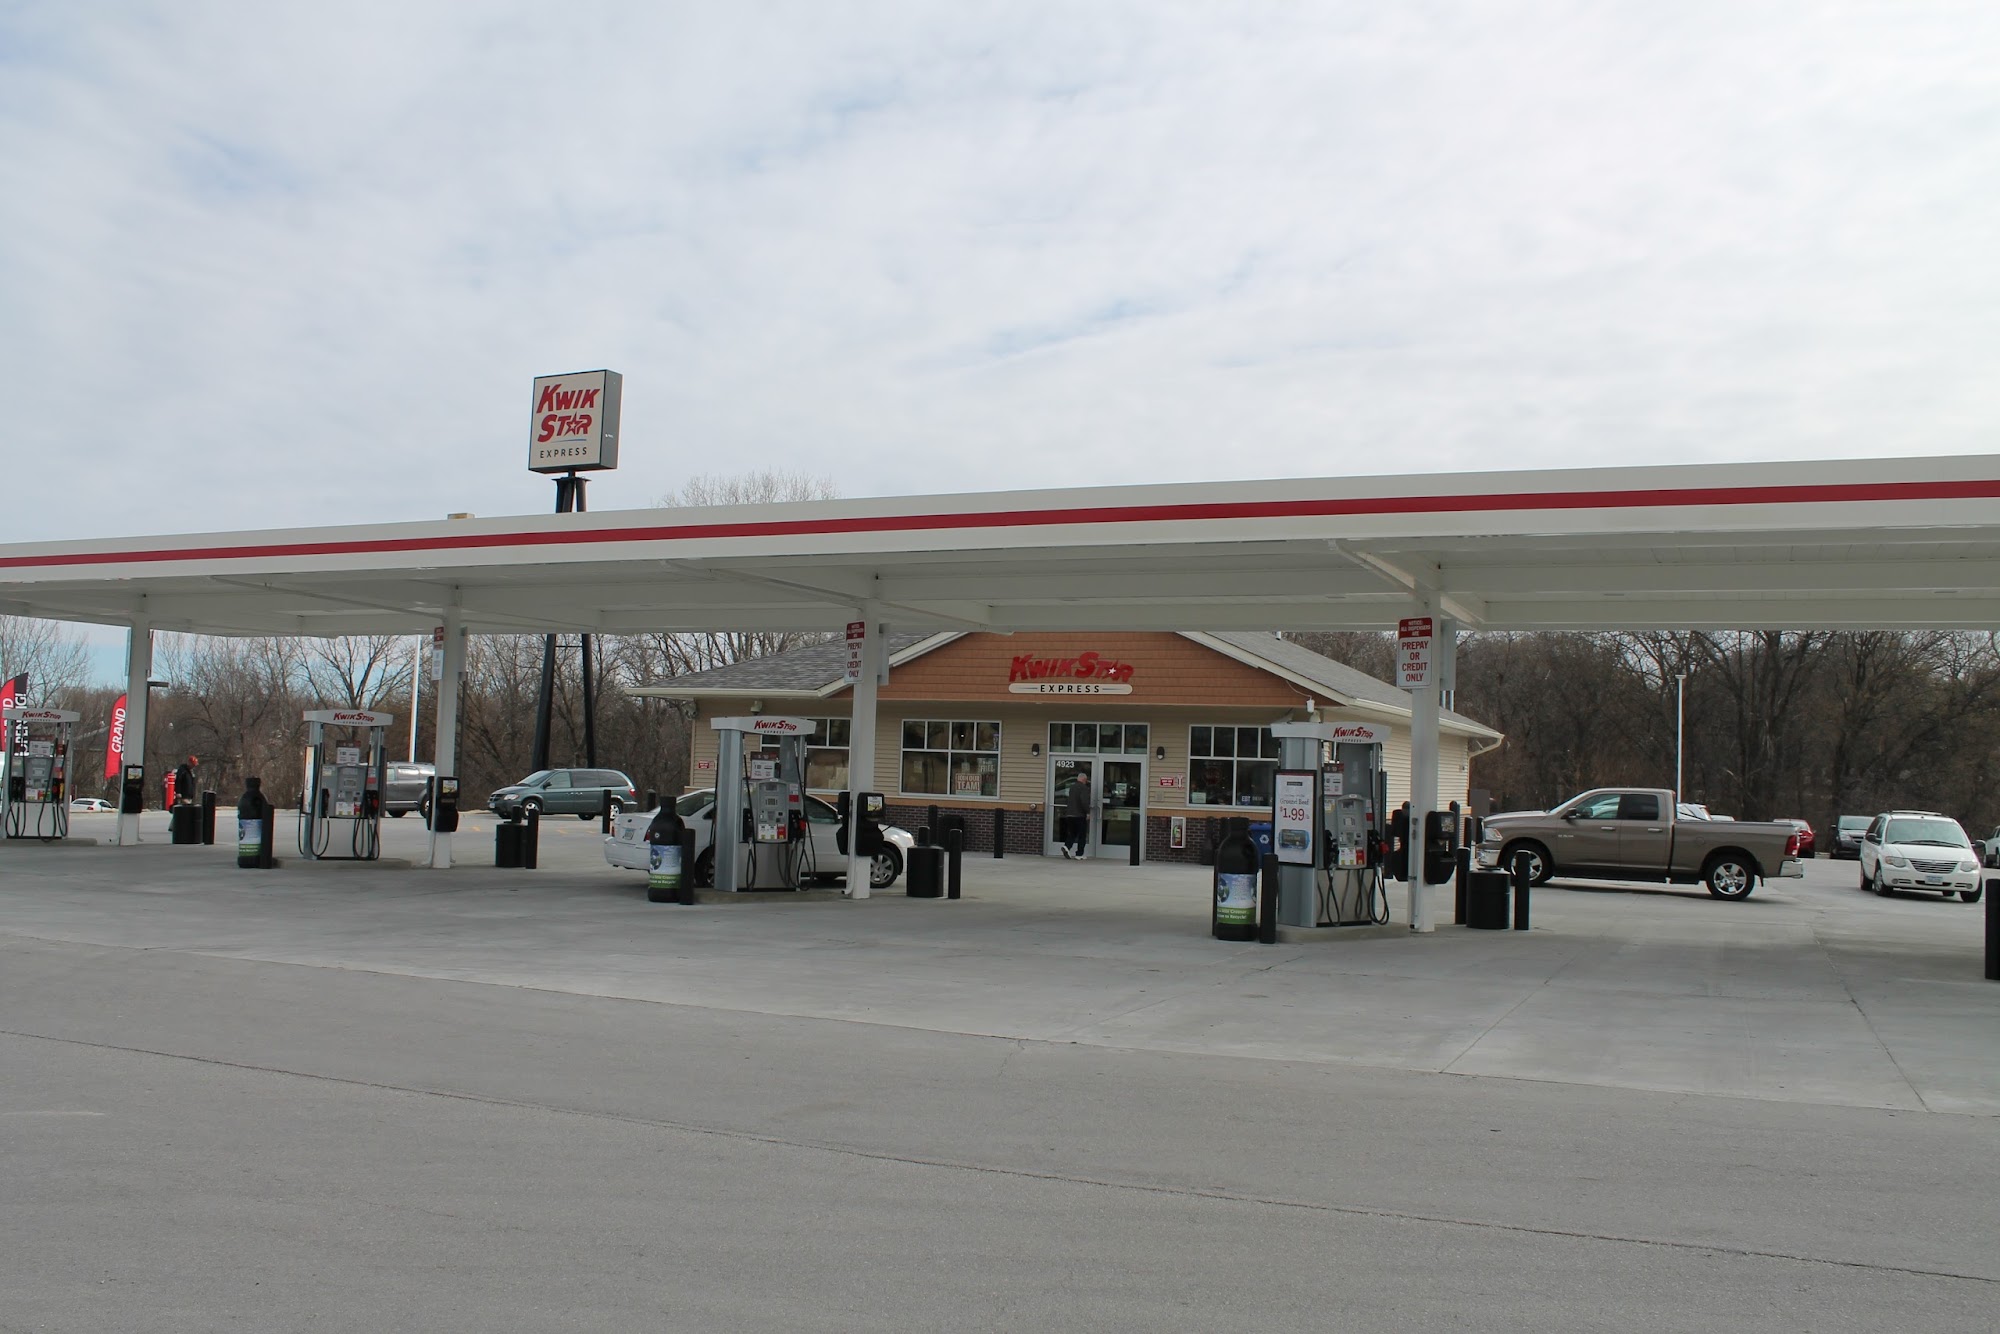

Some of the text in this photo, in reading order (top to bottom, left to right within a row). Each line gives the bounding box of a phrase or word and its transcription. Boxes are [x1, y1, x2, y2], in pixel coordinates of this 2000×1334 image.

[539, 447, 587, 459] EXPRESS
[1401, 640, 1429, 650] PREPAY
[1409, 652, 1420, 660] OR
[1402, 662, 1428, 671] CREDIT
[1405, 673, 1424, 682] ONLY
[1040, 684, 1100, 693] EXPRESS
[111, 708, 126, 753] GRAND
[1056, 760, 1075, 768] 4923
[957, 781, 980, 791] TEAM!
[1279, 806, 1305, 821] $1.99
